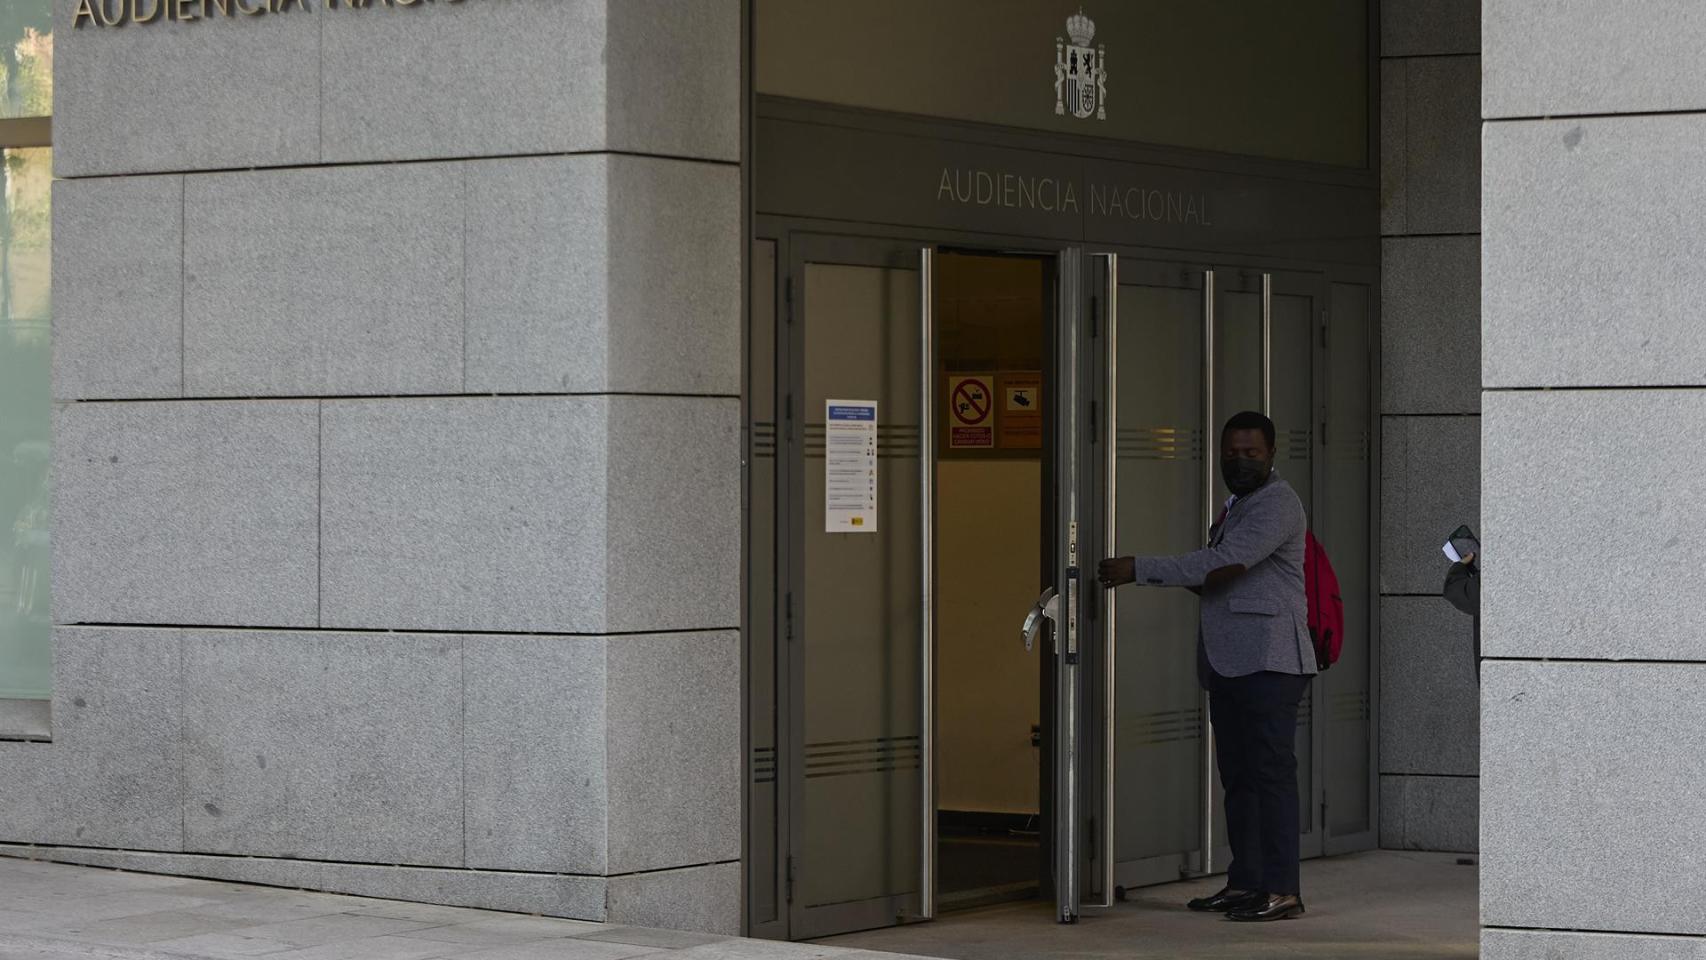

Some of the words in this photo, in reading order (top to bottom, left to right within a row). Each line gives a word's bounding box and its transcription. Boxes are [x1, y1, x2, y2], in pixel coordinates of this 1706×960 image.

[72, 0, 304, 28] AUDIE
[937, 167, 1079, 213] AUDIENCIA
[1090, 183, 1211, 226] NACIONAL
